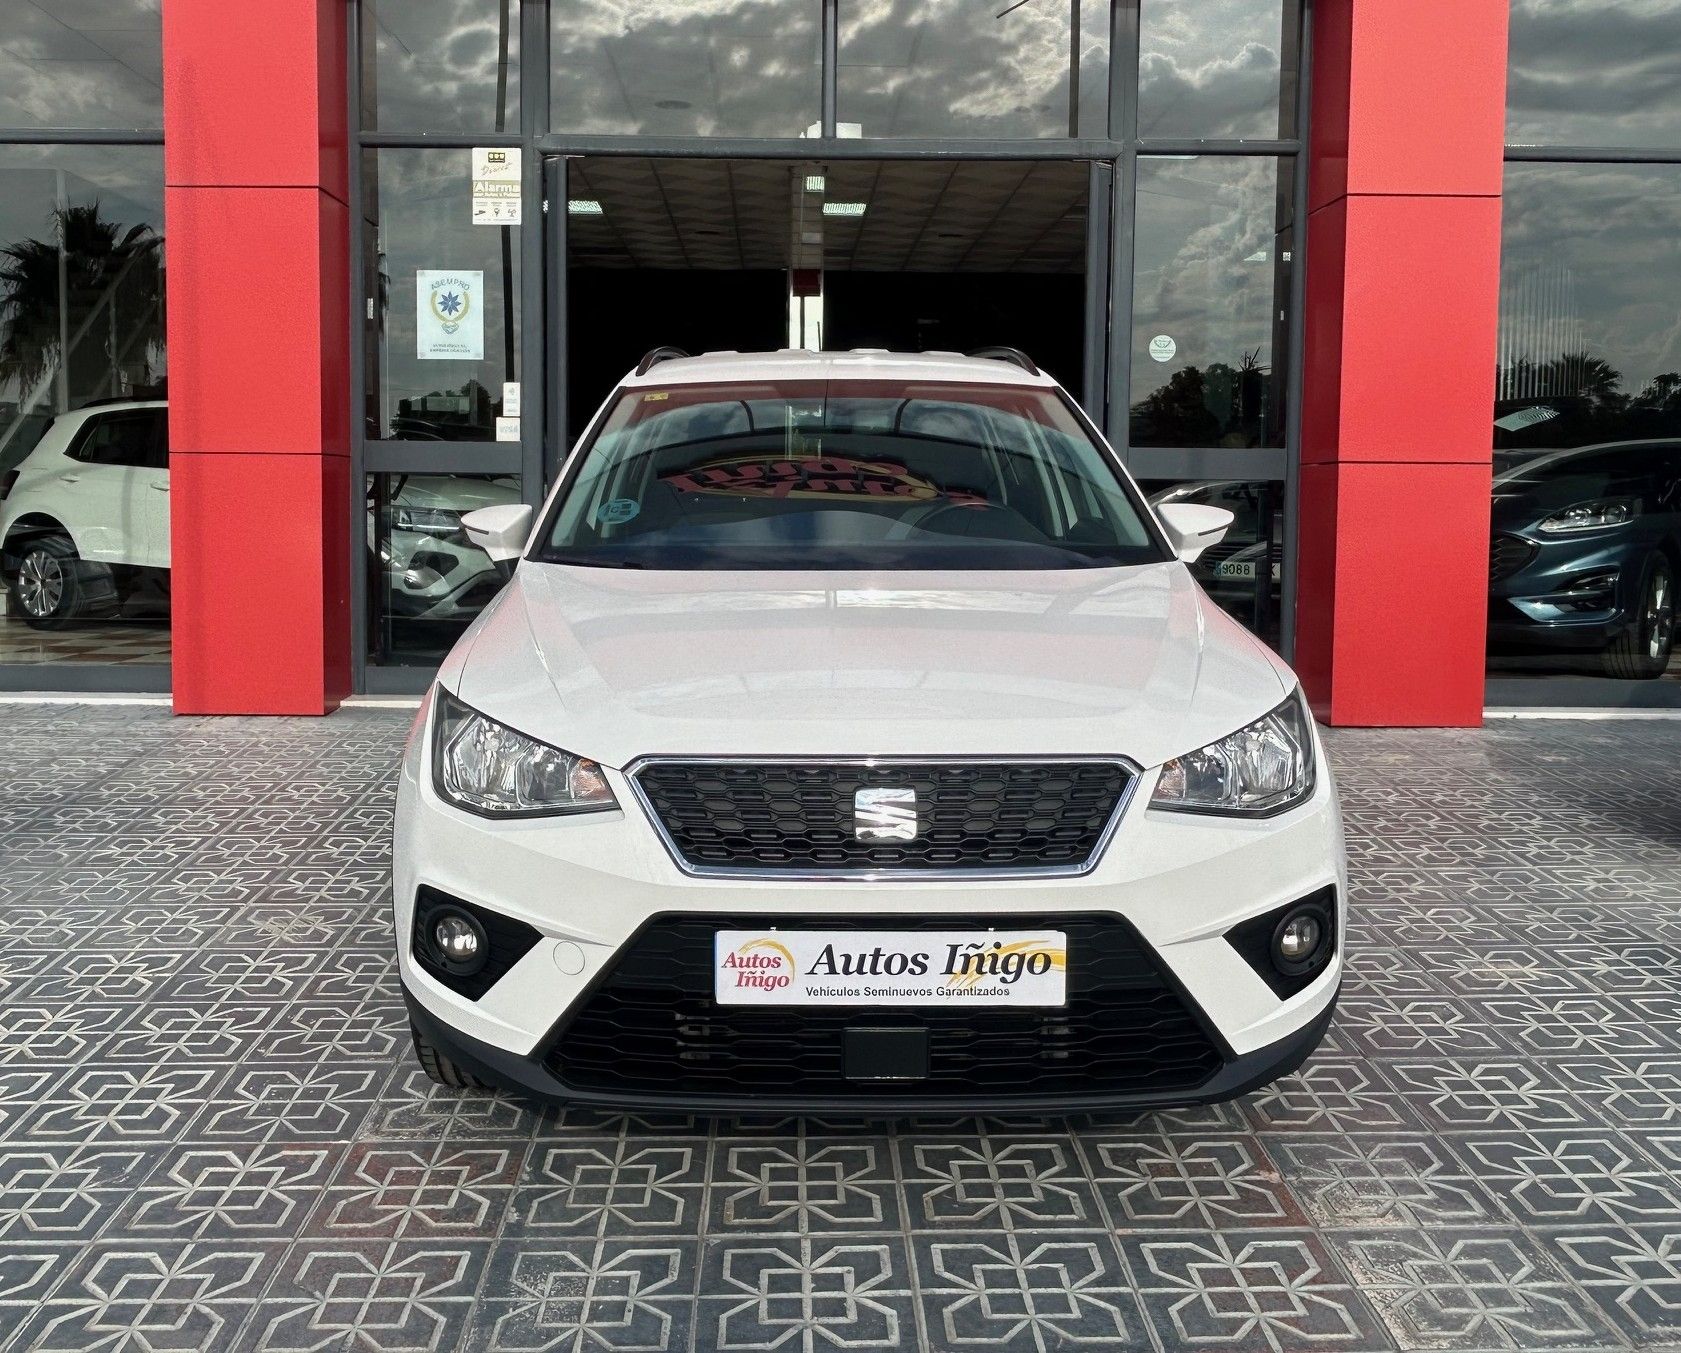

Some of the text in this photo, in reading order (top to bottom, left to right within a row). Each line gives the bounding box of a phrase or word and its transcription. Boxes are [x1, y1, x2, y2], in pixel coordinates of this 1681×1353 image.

[1222, 563, 1250, 575] 9088
[721, 952, 782, 968] Autos
[804, 941, 1052, 984] Autos Iñigo
[735, 970, 790, 992] Iñigo
[863, 986, 933, 997] Seminuevos
[936, 986, 1010, 996] Garantizados
